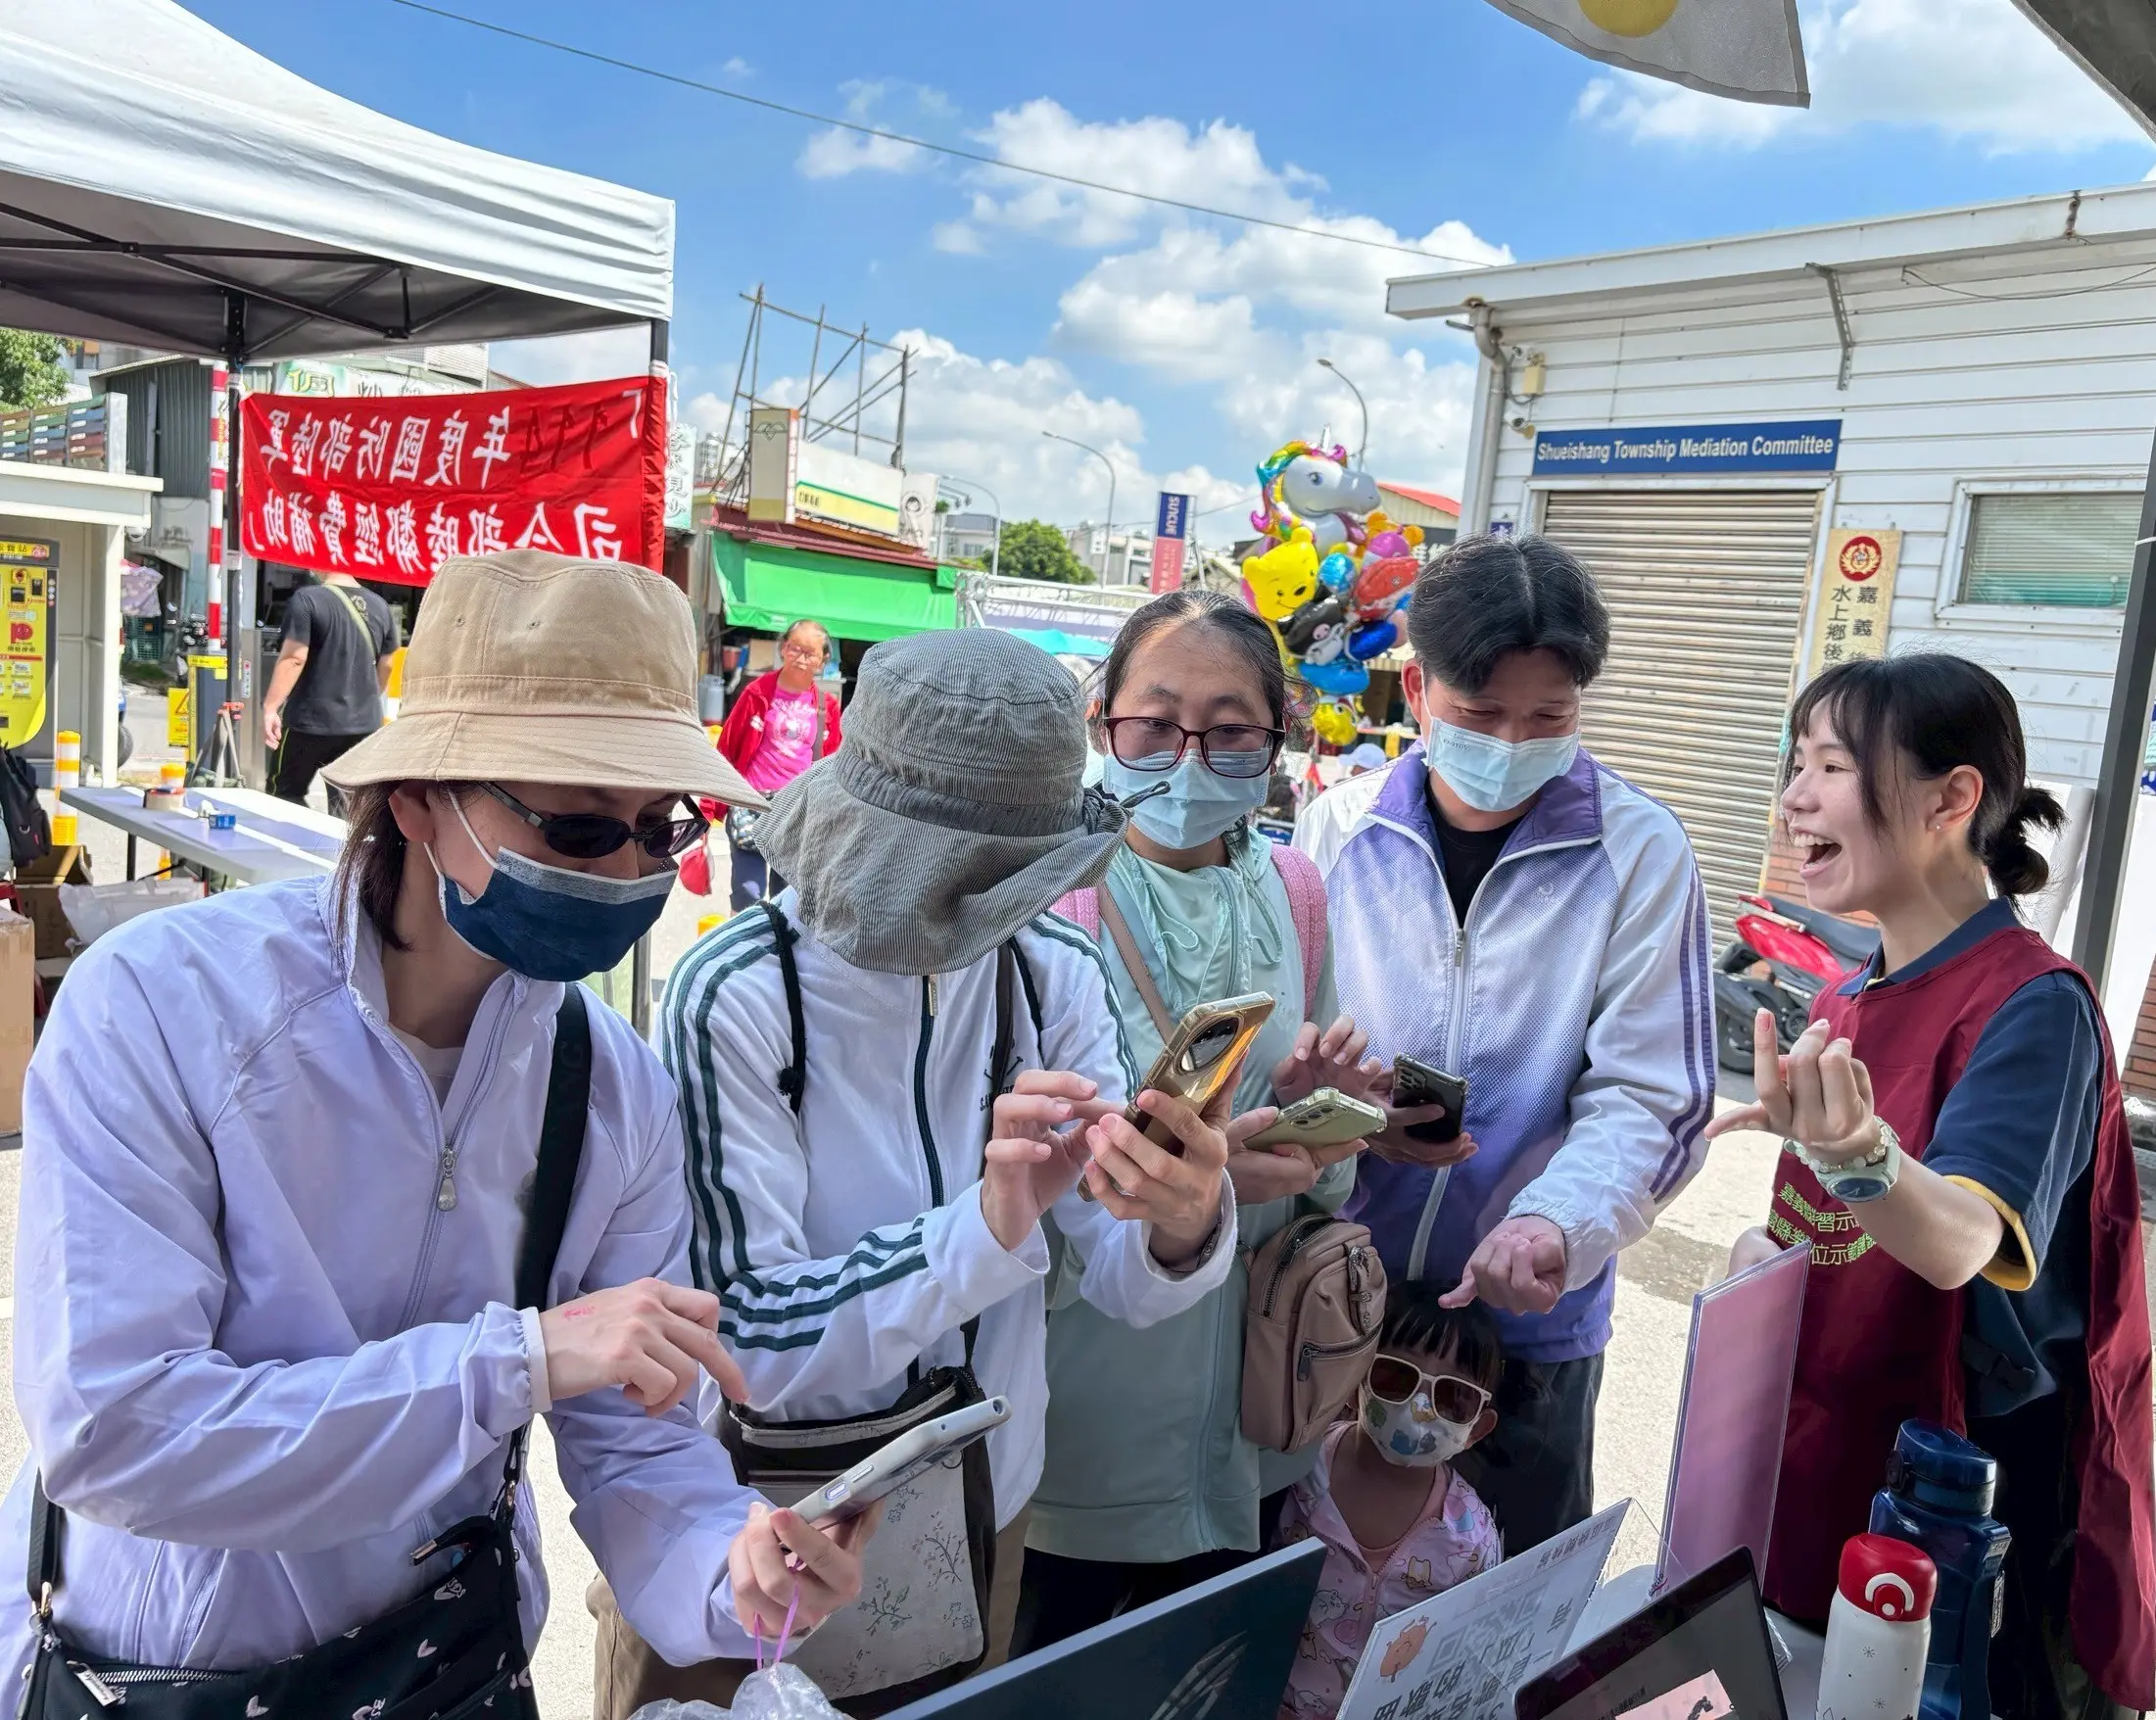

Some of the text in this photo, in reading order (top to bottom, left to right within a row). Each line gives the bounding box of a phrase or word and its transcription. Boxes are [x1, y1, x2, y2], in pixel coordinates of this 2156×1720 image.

[1538, 435, 1834, 463] Shueishang Township Mediation Committee
[1822, 585, 1852, 669] 水上鄉後
